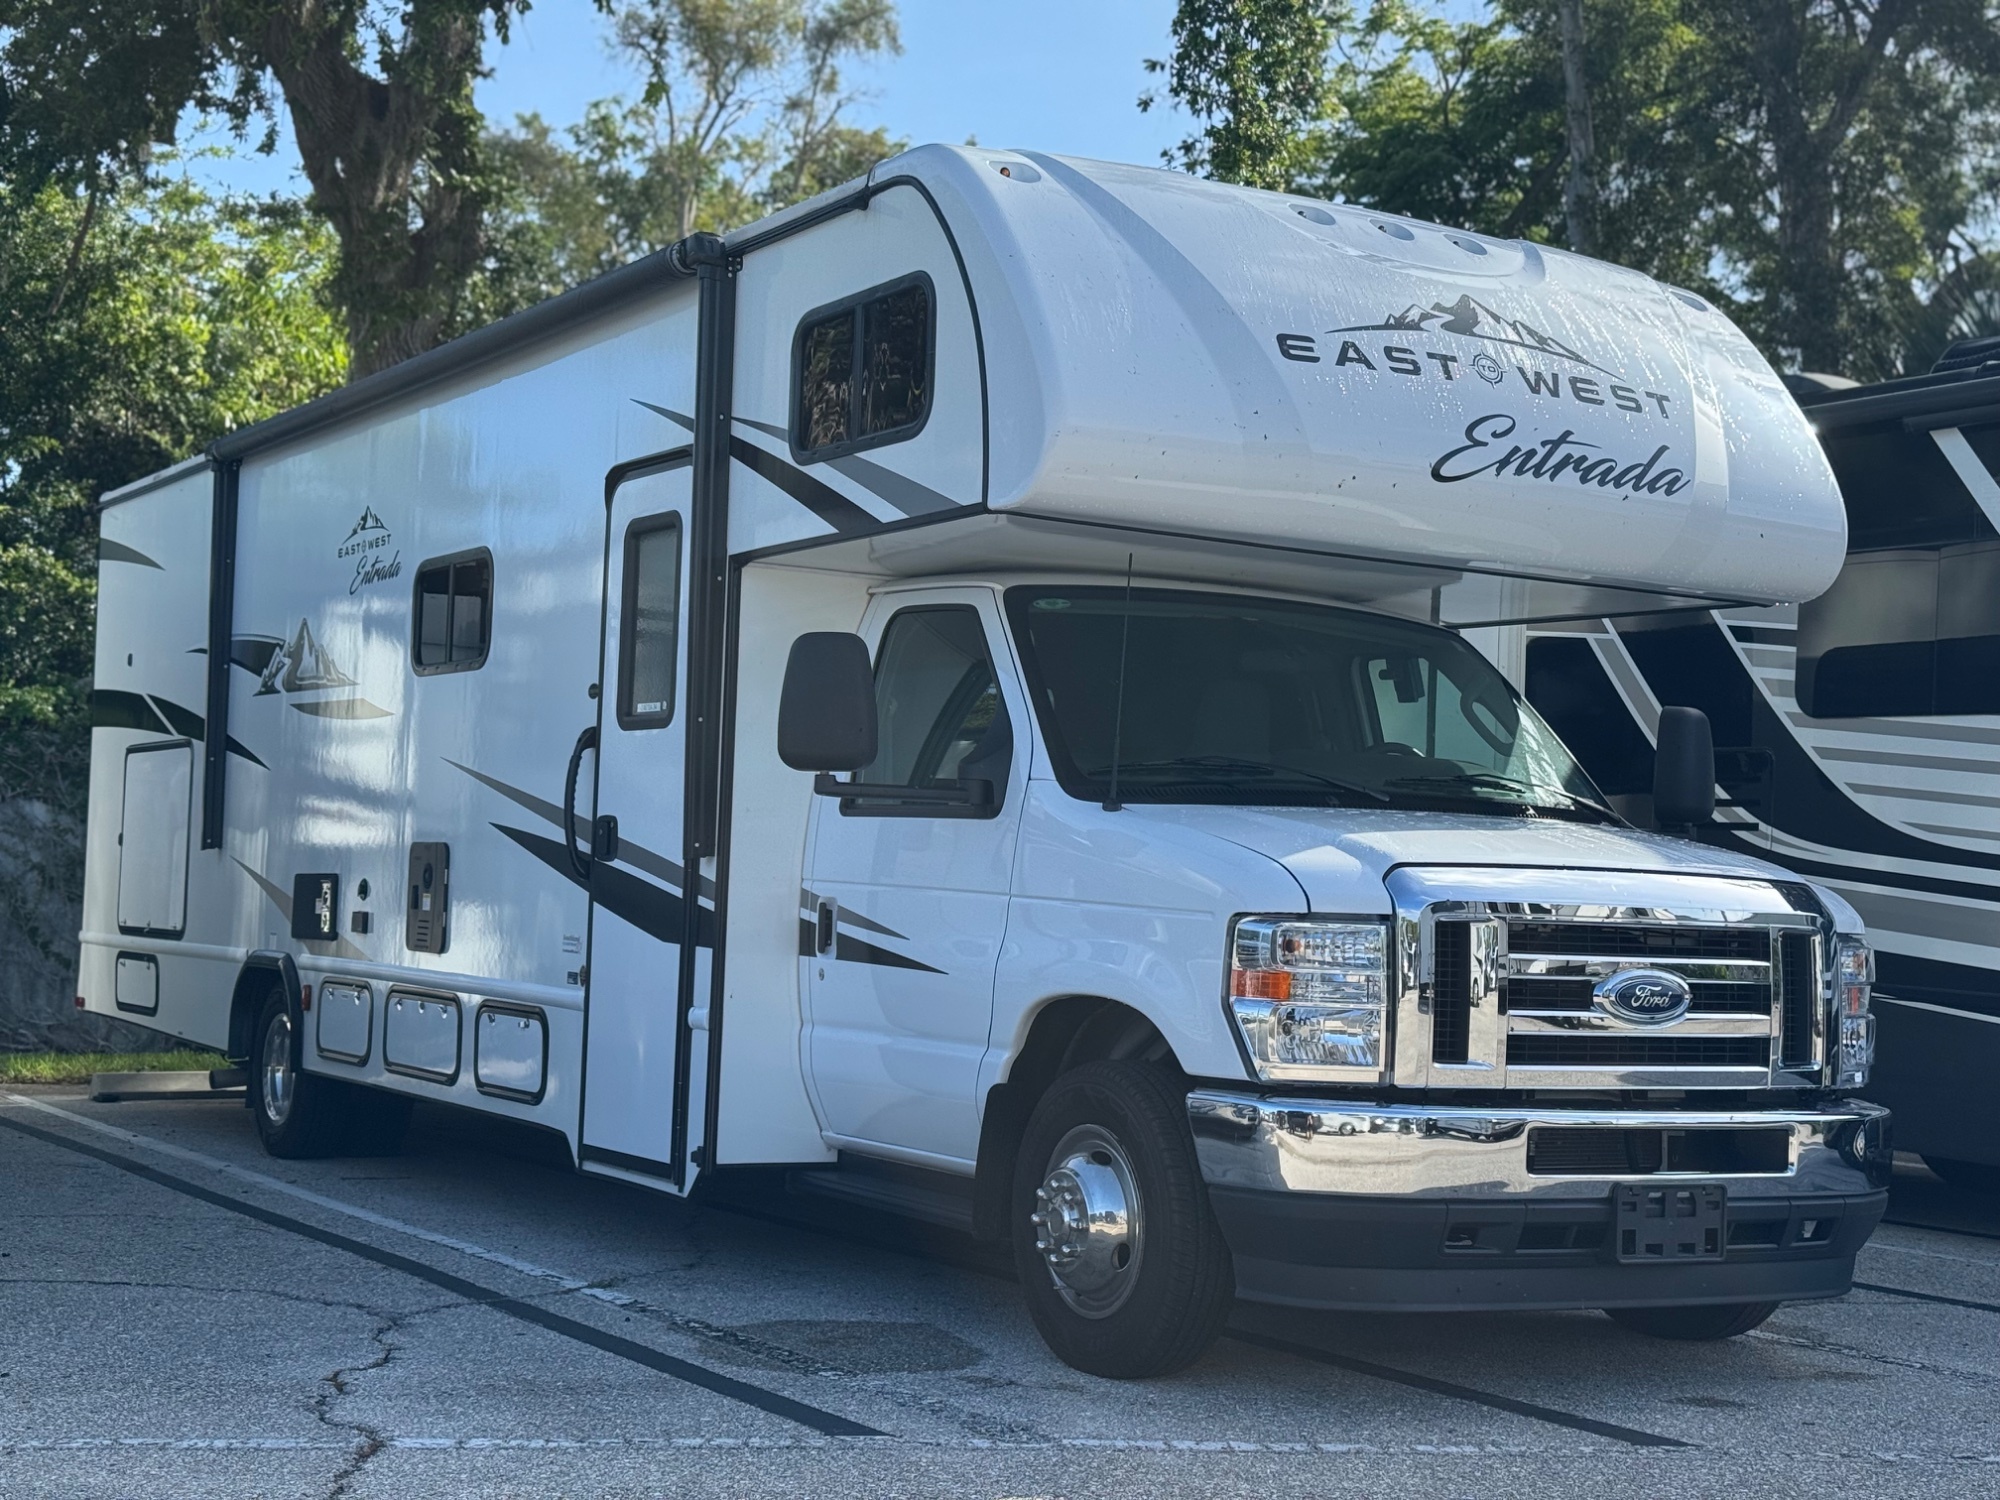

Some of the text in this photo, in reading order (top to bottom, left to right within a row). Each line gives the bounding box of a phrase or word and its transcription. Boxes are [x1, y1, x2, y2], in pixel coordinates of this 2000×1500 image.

[1276, 333, 1672, 420] EAST TO WEST
[1430, 414, 1691, 497] Entrada
[338, 543, 361, 558] EAST
[367, 534, 391, 550] WEST
[349, 550, 401, 595] Entrada
[1631, 985, 1672, 1008] Ford
